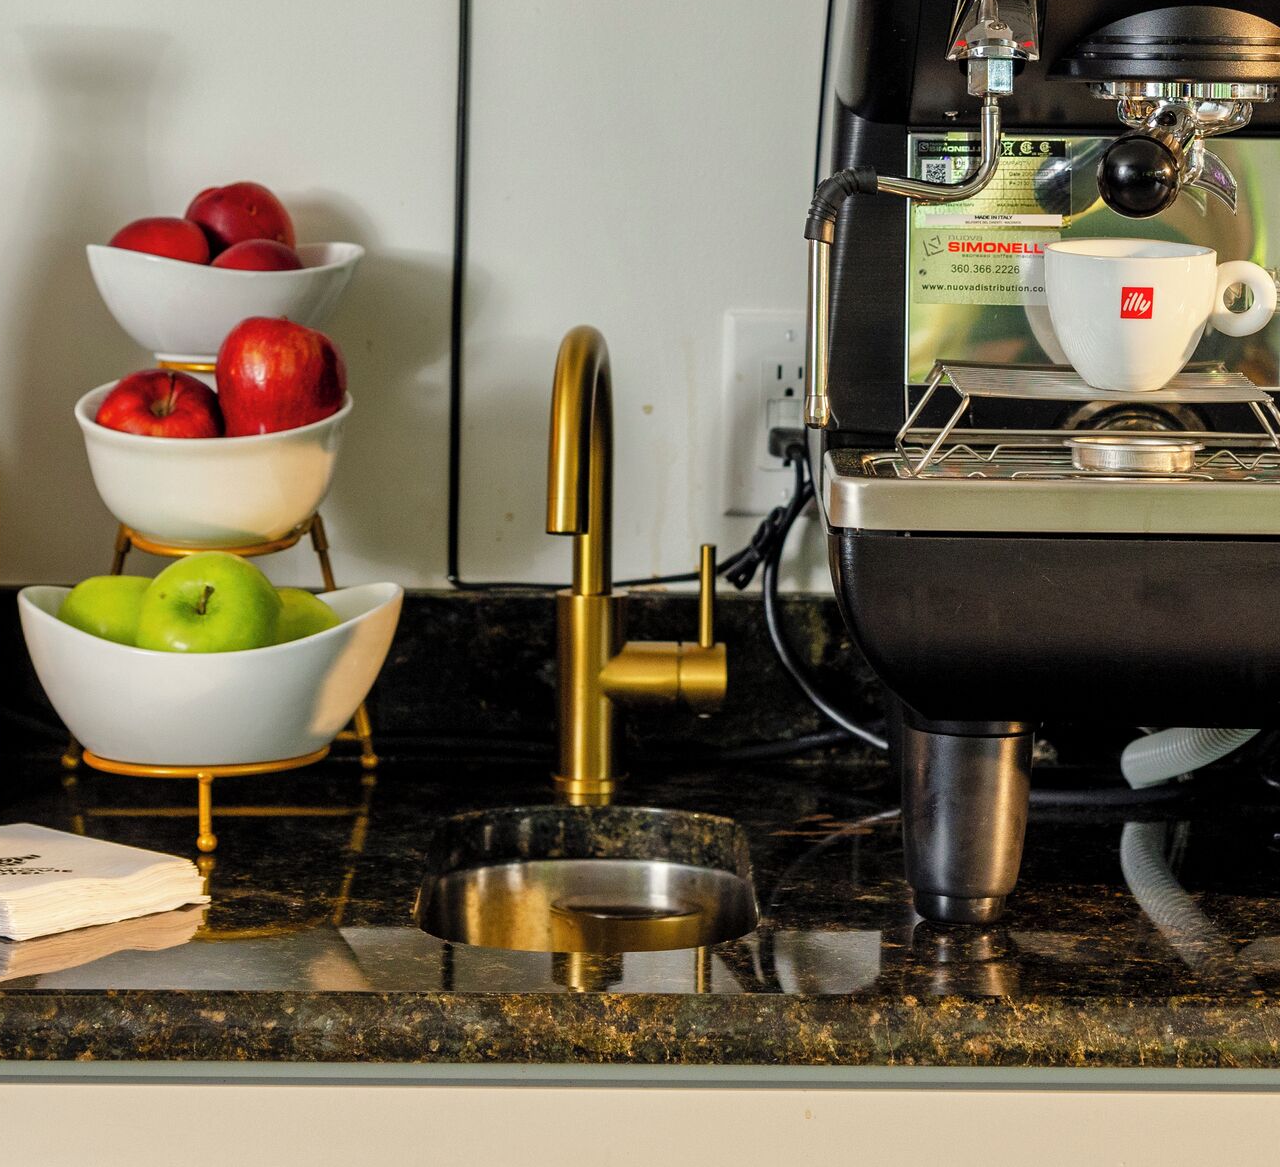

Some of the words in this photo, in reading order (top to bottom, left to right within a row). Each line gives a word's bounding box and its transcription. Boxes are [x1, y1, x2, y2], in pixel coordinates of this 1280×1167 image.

[951, 263, 1020, 274] 360.366.2226
[921, 282, 1046, 294] www.nuovadistribution.co
[1123, 292, 1151, 316] illy
